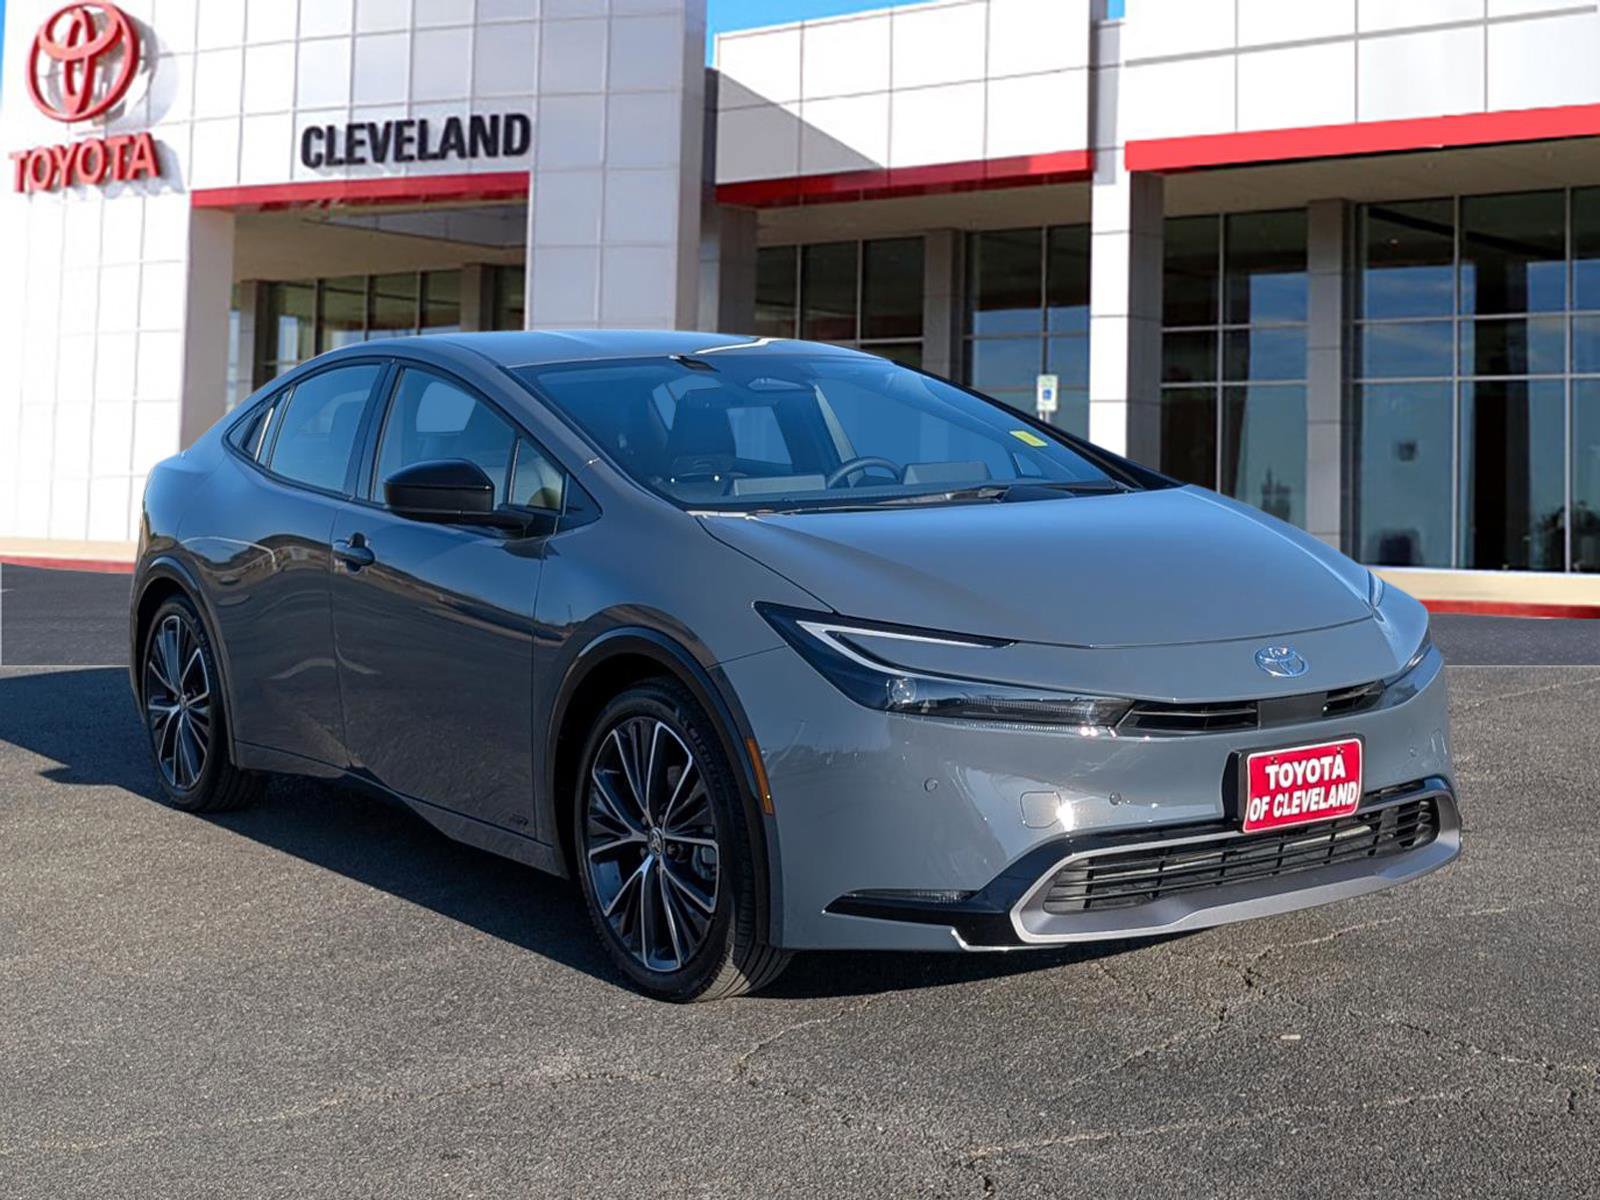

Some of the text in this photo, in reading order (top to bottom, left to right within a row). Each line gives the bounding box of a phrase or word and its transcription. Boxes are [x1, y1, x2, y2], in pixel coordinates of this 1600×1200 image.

[9, 132, 160, 193] TOYOTA
[300, 113, 531, 169] CLEVELAND
[1265, 755, 1346, 789] TOYOTA
[1250, 782, 1358, 821] OF CLEVELAND
